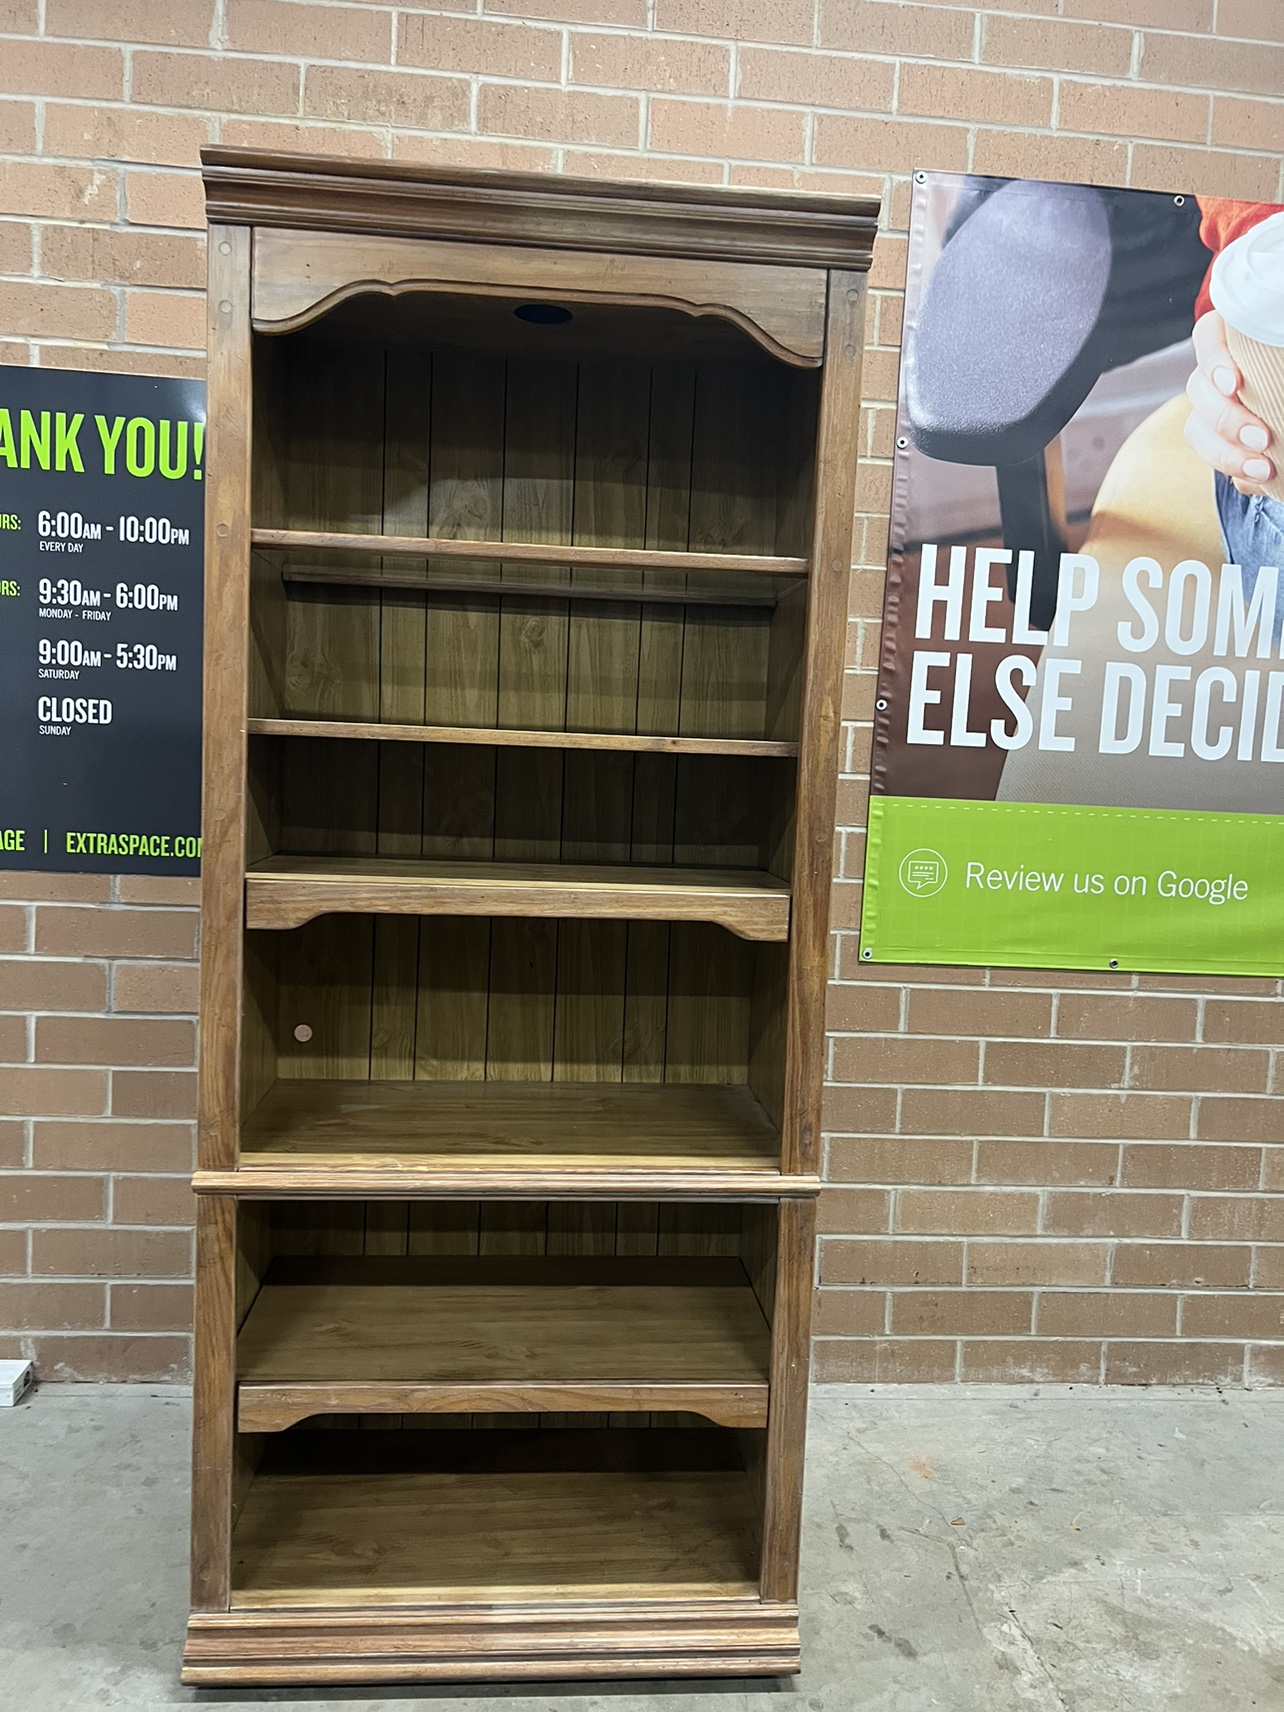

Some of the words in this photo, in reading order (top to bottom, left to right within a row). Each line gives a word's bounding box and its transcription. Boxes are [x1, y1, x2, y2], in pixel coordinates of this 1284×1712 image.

[0, 408, 85, 473] ANK
[94, 414, 205, 480] YOU!
[0, 513, 22, 531] RS:
[38, 510, 102, 540] 6:00AM
[119, 515, 190, 546] 10:00PM
[39, 541, 66, 553] EVERY
[67, 543, 84, 553] DAY
[0, 580, 21, 597] RS:
[39, 578, 101, 607] 9:30AM
[115, 582, 178, 611] 6:00PM
[915, 543, 1100, 647] HELP
[1116, 556, 1284, 660] SOM
[39, 607, 73, 620] MONDAY
[82, 609, 112, 621] FRIDAY
[38, 638, 102, 667] 9:00AM
[116, 643, 177, 671] 5:30PM
[38, 668, 80, 680] SATURDAY
[37, 696, 113, 724] CLOSED
[906, 650, 1082, 752] ELSE
[39, 725, 72, 736] SUNDAY
[965, 861, 1065, 893] Review
[1072, 873, 1105, 894] us
[1113, 875, 1147, 896] on
[1157, 870, 1249, 906] Google
